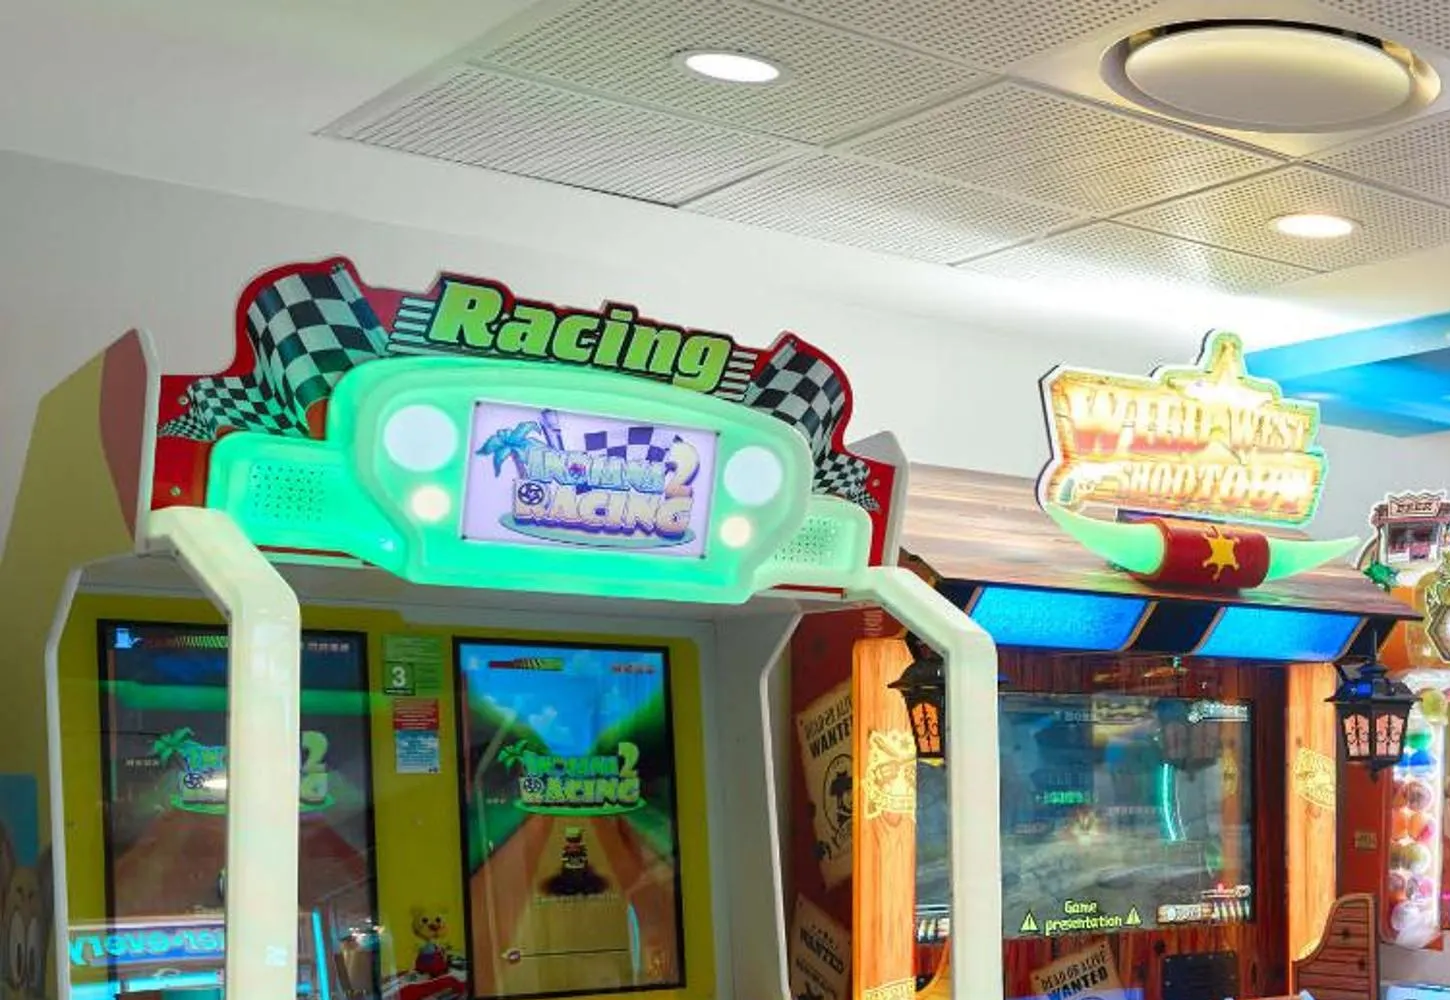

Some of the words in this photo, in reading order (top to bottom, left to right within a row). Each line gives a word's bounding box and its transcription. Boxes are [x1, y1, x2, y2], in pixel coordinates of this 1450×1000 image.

[427, 279, 732, 393] Racing
[664, 433, 700, 499] 2
[391, 665, 406, 688] 3
[809, 714, 852, 759] WANTE
[1064, 900, 1098, 914] Game
[1044, 915, 1123, 936] presentation
